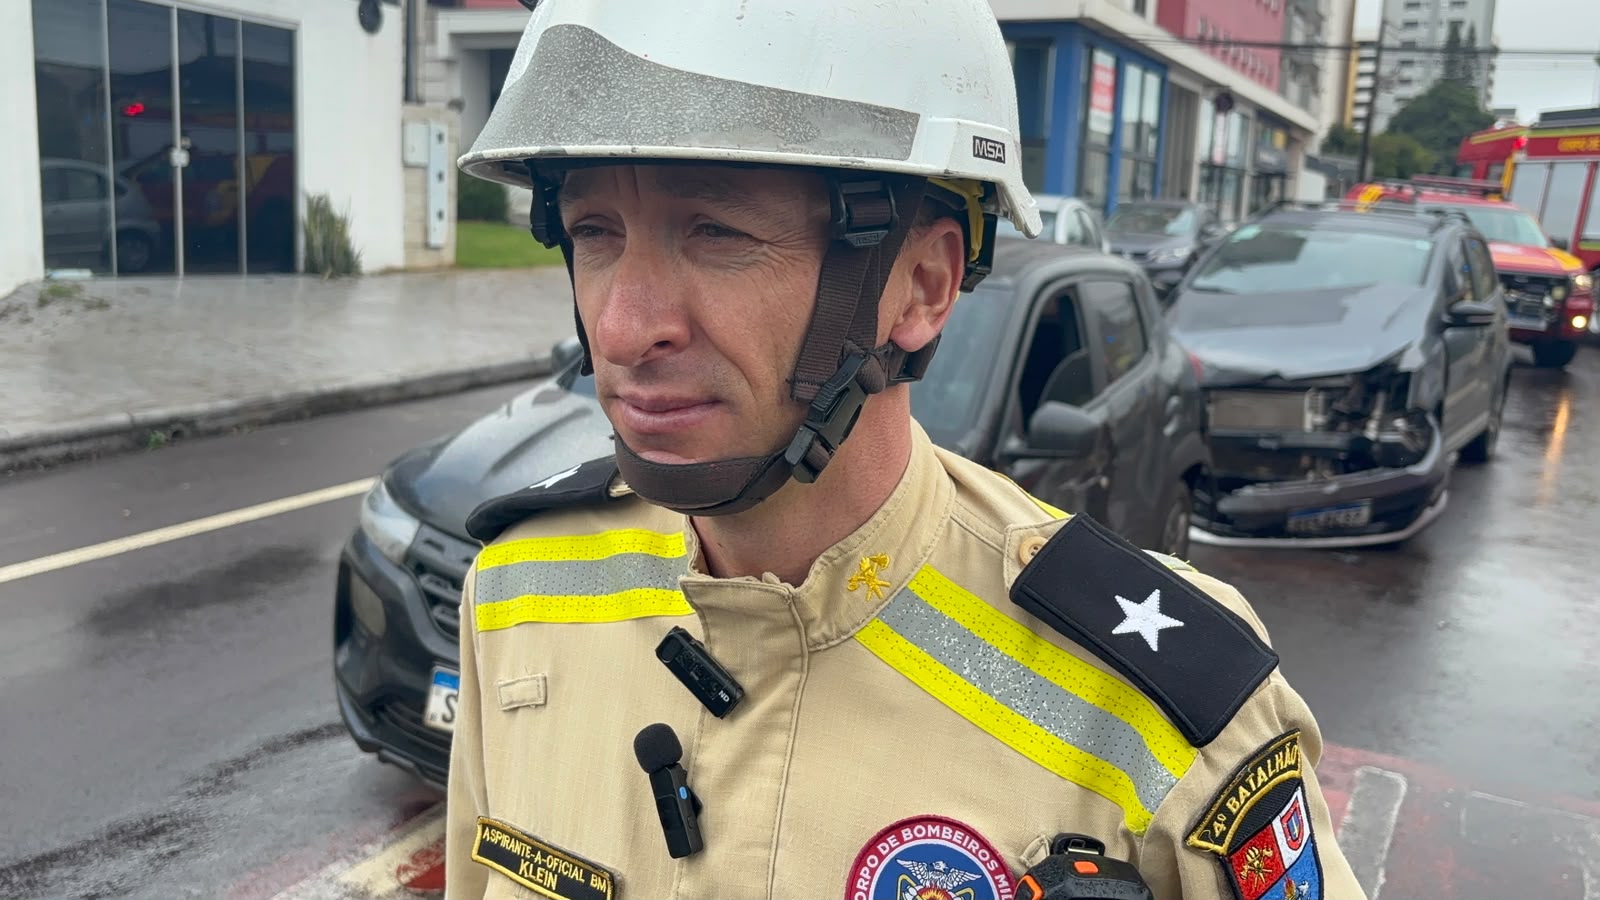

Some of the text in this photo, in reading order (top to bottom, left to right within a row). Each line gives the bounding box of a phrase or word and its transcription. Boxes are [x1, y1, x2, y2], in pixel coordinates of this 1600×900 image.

[974, 138, 1005, 162] MSA
[1226, 742, 1300, 815] BATALHÃO
[482, 826, 608, 893] ASPIRANTE-A-OFICIAL BM
[518, 858, 559, 891] KLEIN
[854, 854, 879, 900] ORPO
[876, 834, 901, 856] DE
[900, 824, 999, 872] BOMBEIROS
